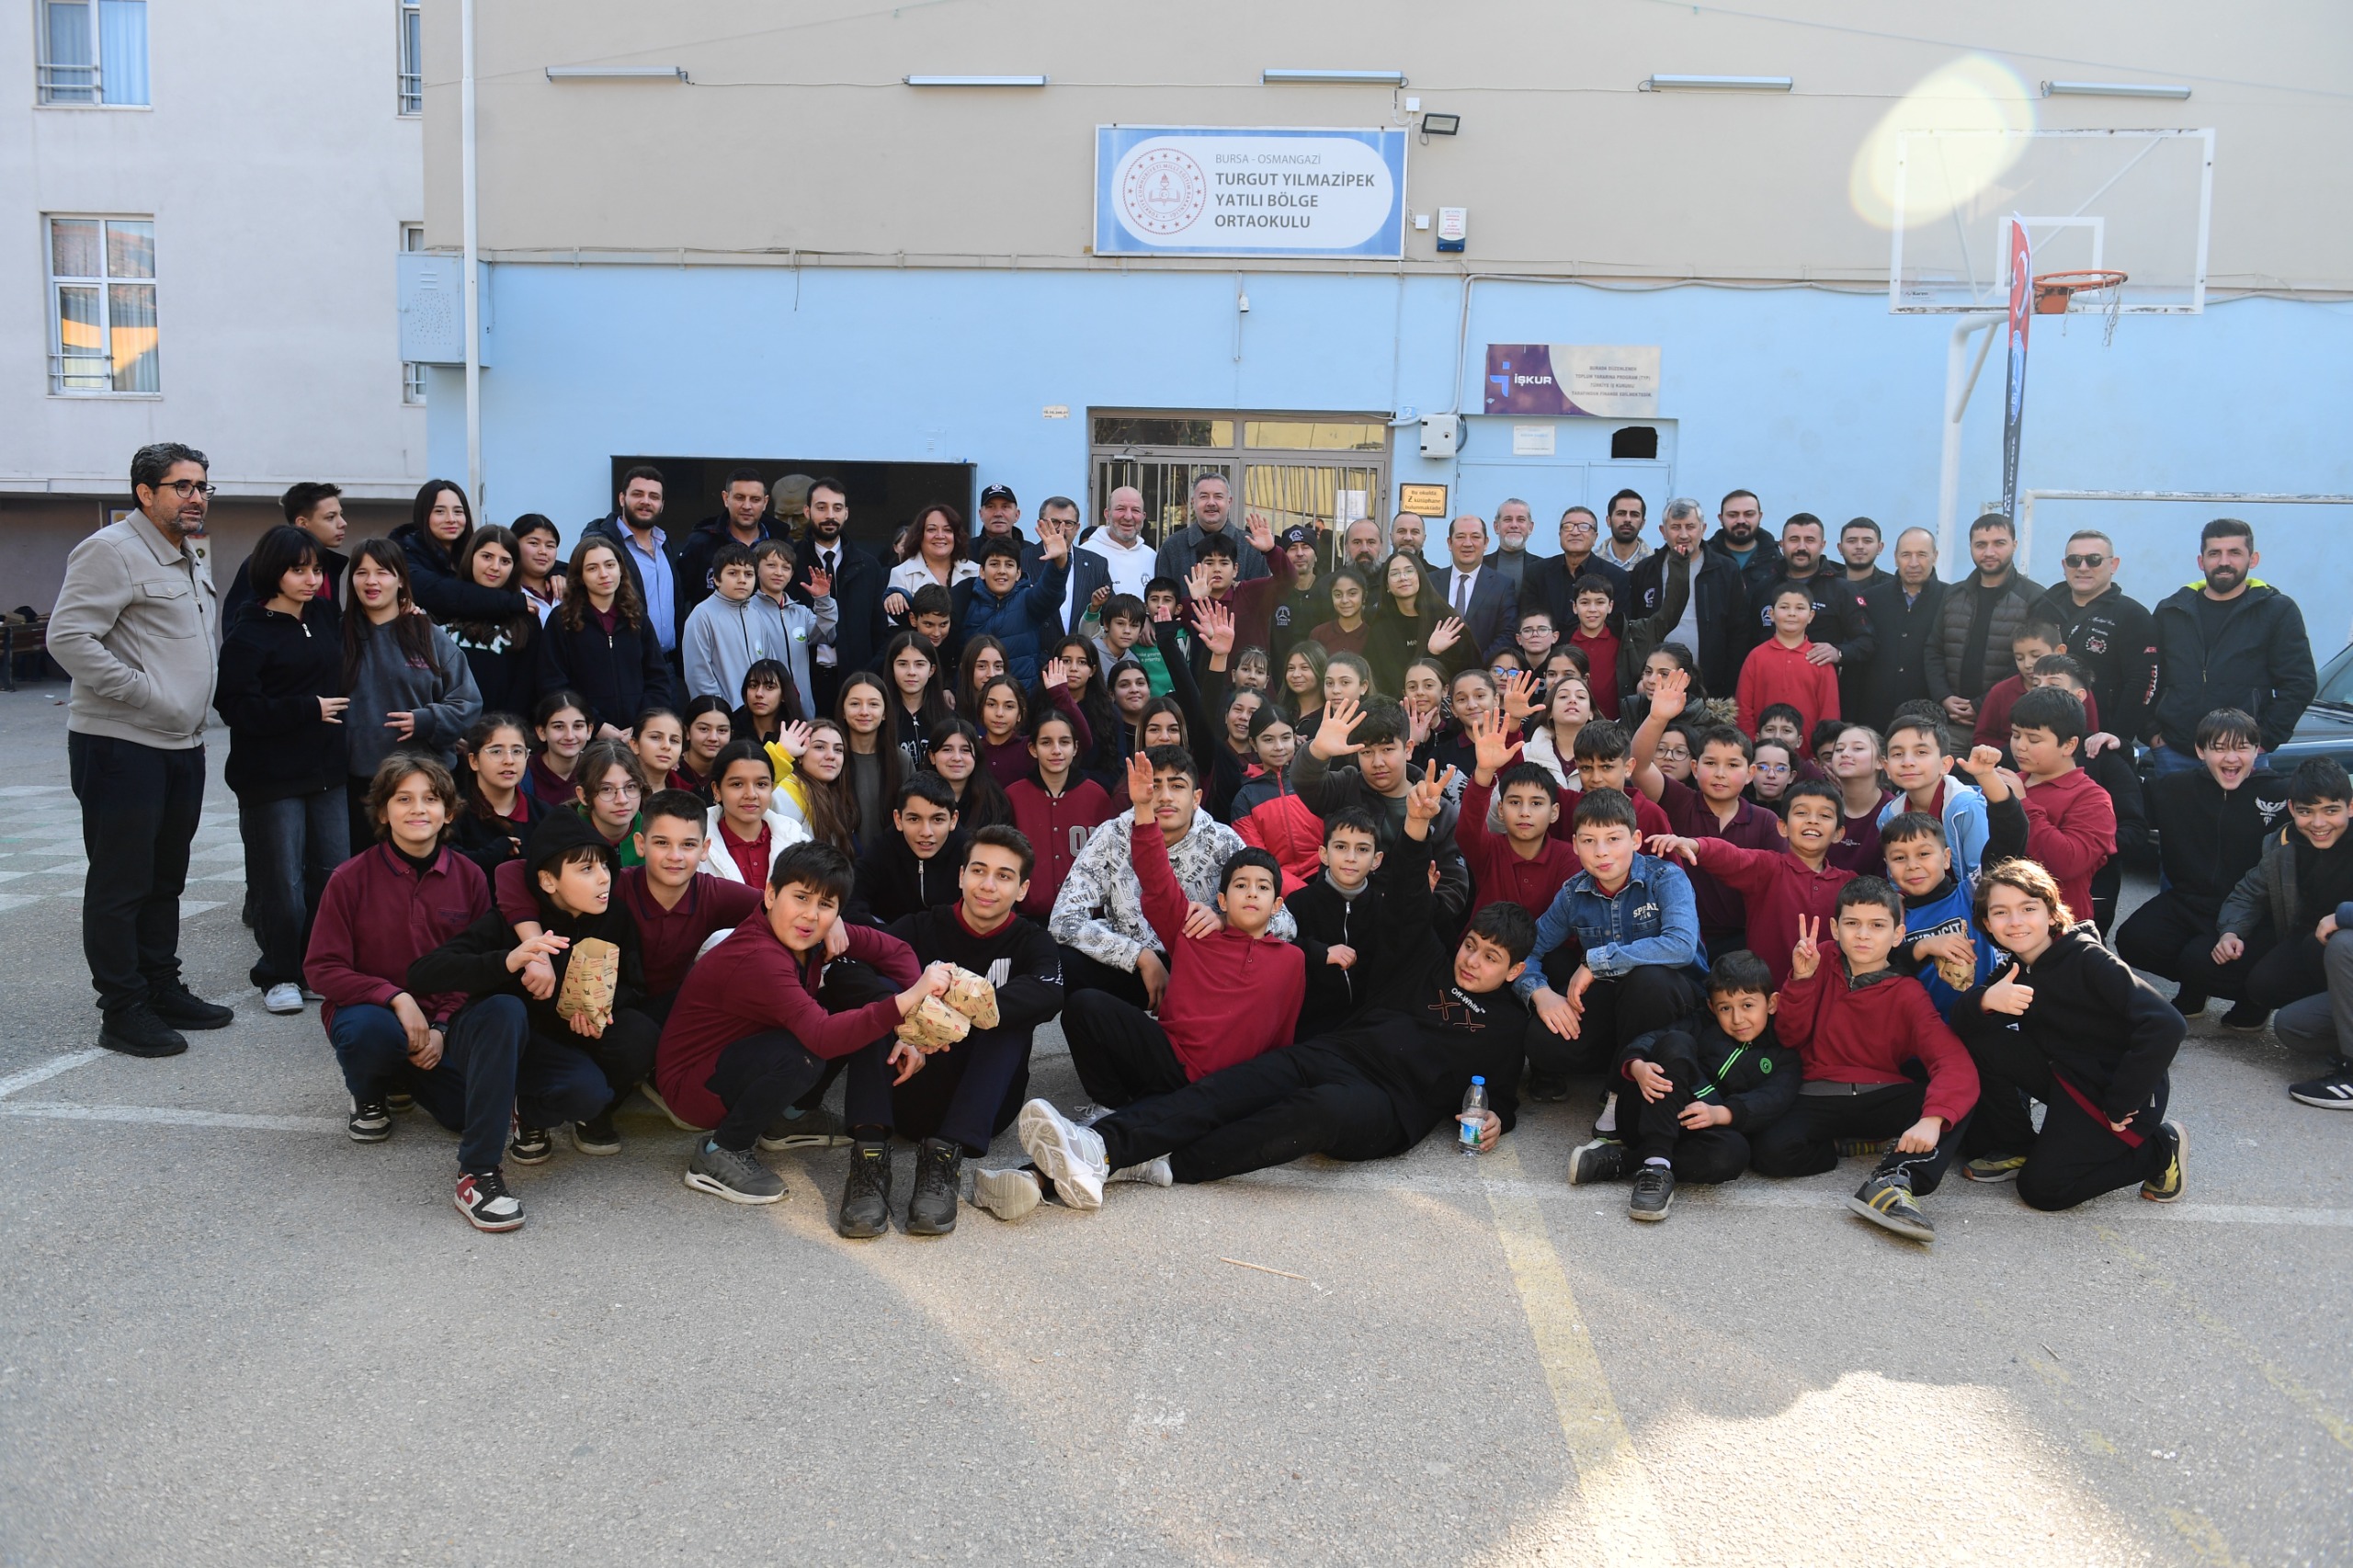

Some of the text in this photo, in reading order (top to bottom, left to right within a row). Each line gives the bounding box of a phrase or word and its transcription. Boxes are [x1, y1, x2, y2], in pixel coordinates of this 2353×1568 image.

[1215, 154, 1249, 163] BURSA
[1258, 153, 1321, 164] OSMANGAZİ
[1215, 171, 1375, 187] TURGUT YILMAZİPEK
[1215, 191, 1319, 207] YATILI BÖLGE
[1215, 215, 1311, 228] ORTAOKULU
[1514, 373, 1552, 386] İŞKUR
